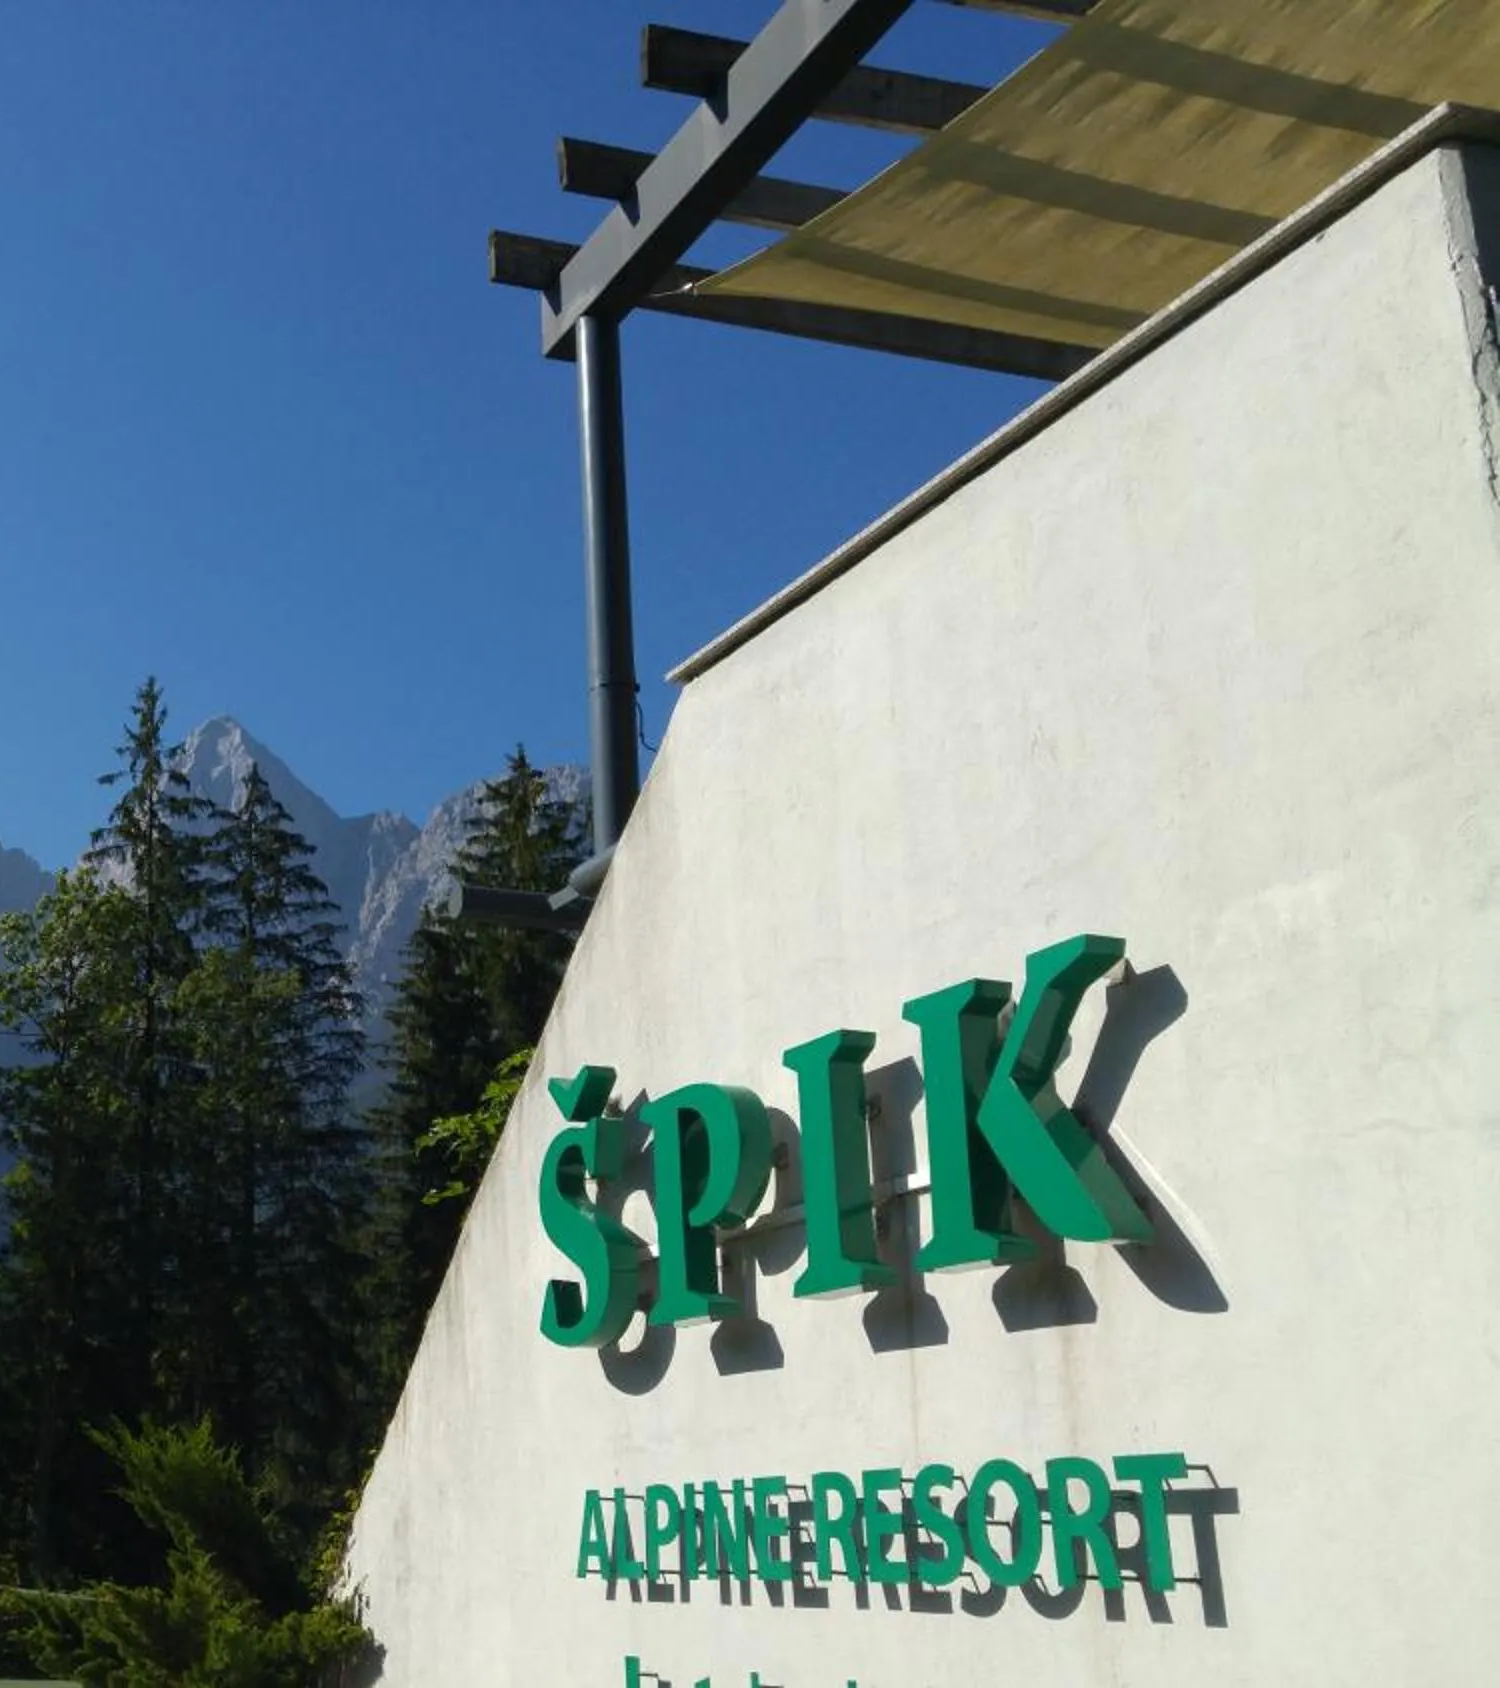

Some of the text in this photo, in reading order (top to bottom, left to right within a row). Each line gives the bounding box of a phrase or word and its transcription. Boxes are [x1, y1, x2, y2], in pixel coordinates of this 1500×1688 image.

[539, 933, 1156, 1348] ŠPIK
[577, 1452, 1188, 1592] ALPINE RESORT
